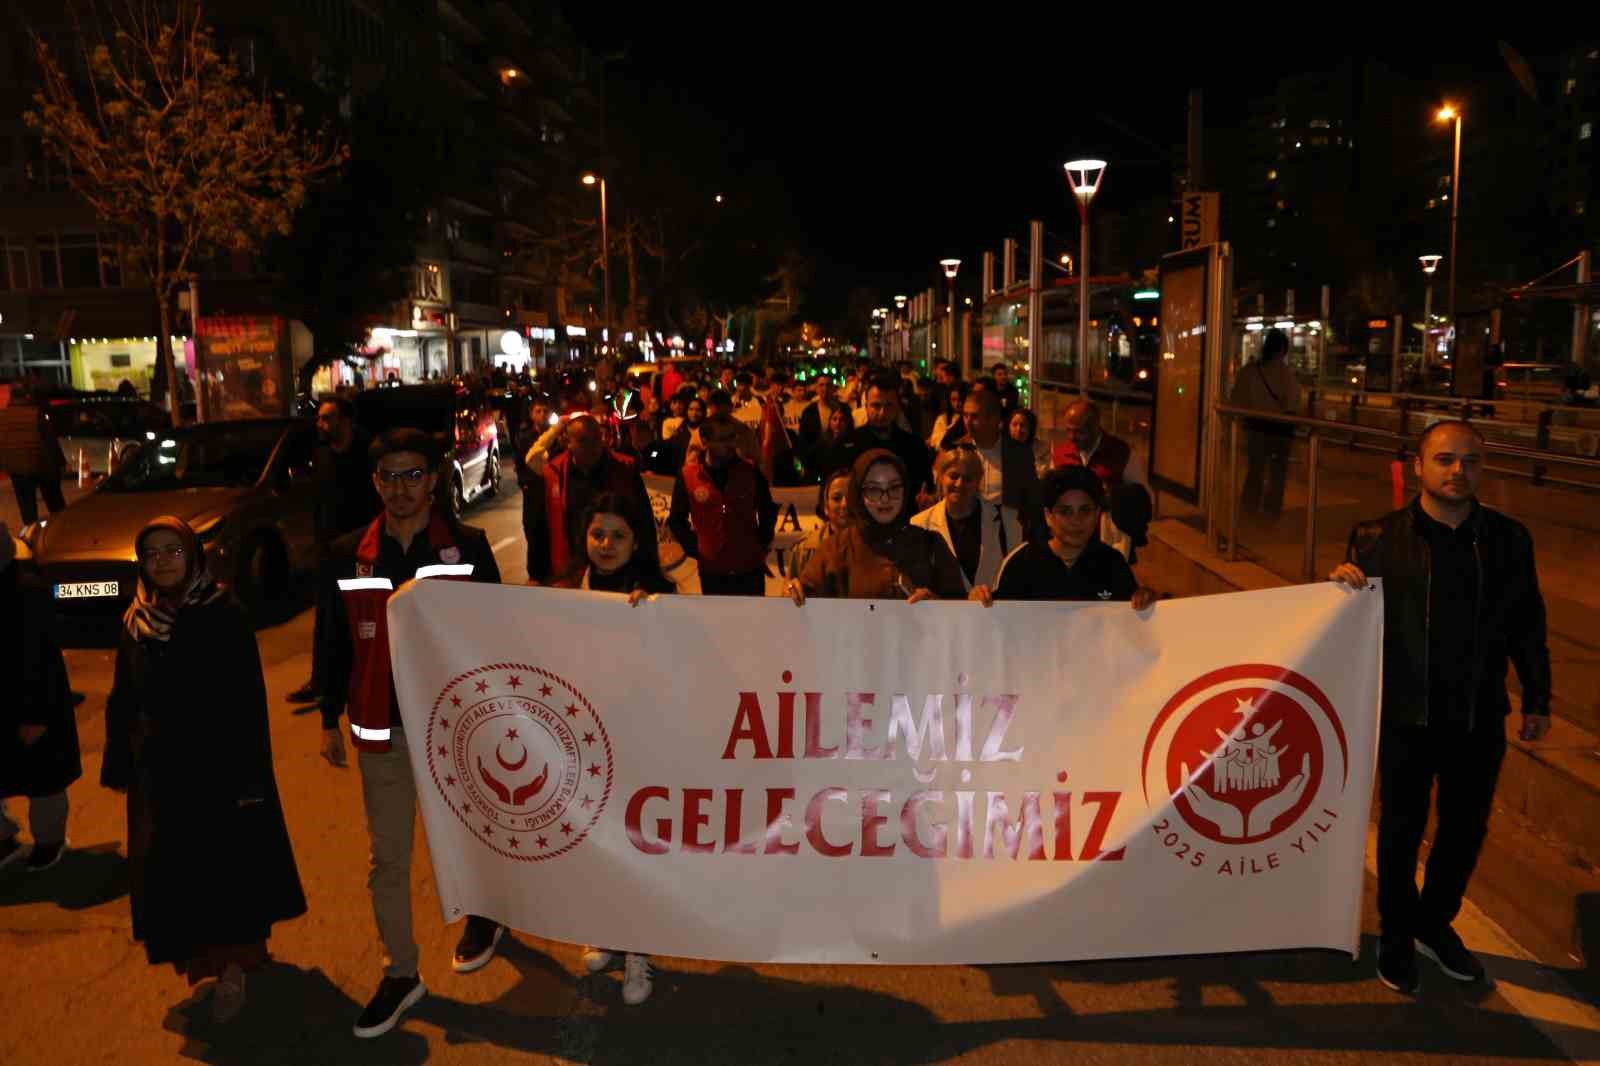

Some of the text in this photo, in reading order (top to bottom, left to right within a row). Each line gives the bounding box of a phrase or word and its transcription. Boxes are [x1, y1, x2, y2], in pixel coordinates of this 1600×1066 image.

[60, 583, 117, 597] 34 KNS 08
[721, 669, 1025, 762] AİLEMİZ
[624, 767, 1127, 862] GELECEĞİMİZ
[1152, 808, 1338, 876] 2025 AİLE YILI
